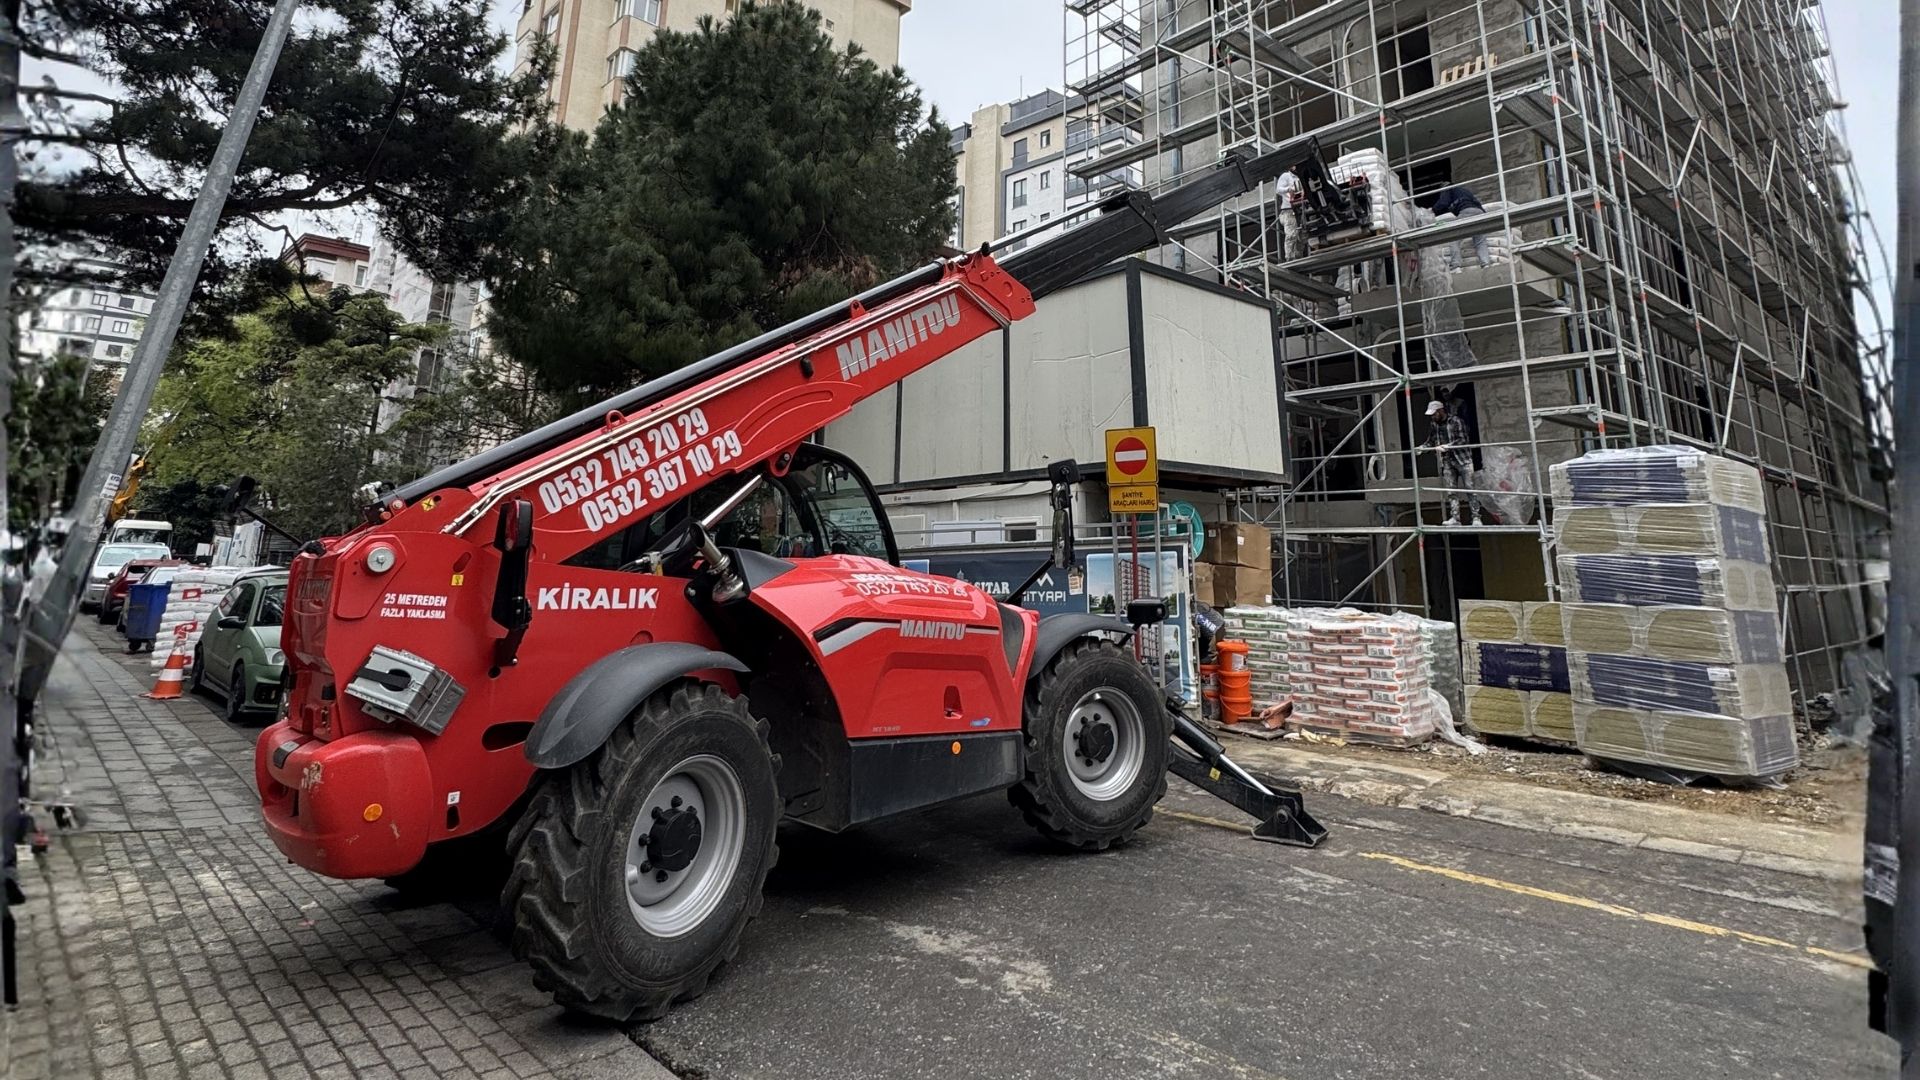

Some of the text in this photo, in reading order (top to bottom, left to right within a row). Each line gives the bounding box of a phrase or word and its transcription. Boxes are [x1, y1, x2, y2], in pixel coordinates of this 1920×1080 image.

[836, 293, 960, 381] MANITOU
[538, 407, 709, 514] 0532 743 20 29
[581, 430, 743, 532] 0532 367 10 29
[384, 593, 448, 607] 25 METREDEN
[537, 582, 658, 610] KİRALIK
[856, 581, 900, 595] 0532
[380, 607, 405, 618] FAZLA
[900, 619, 966, 640] MANITOU
